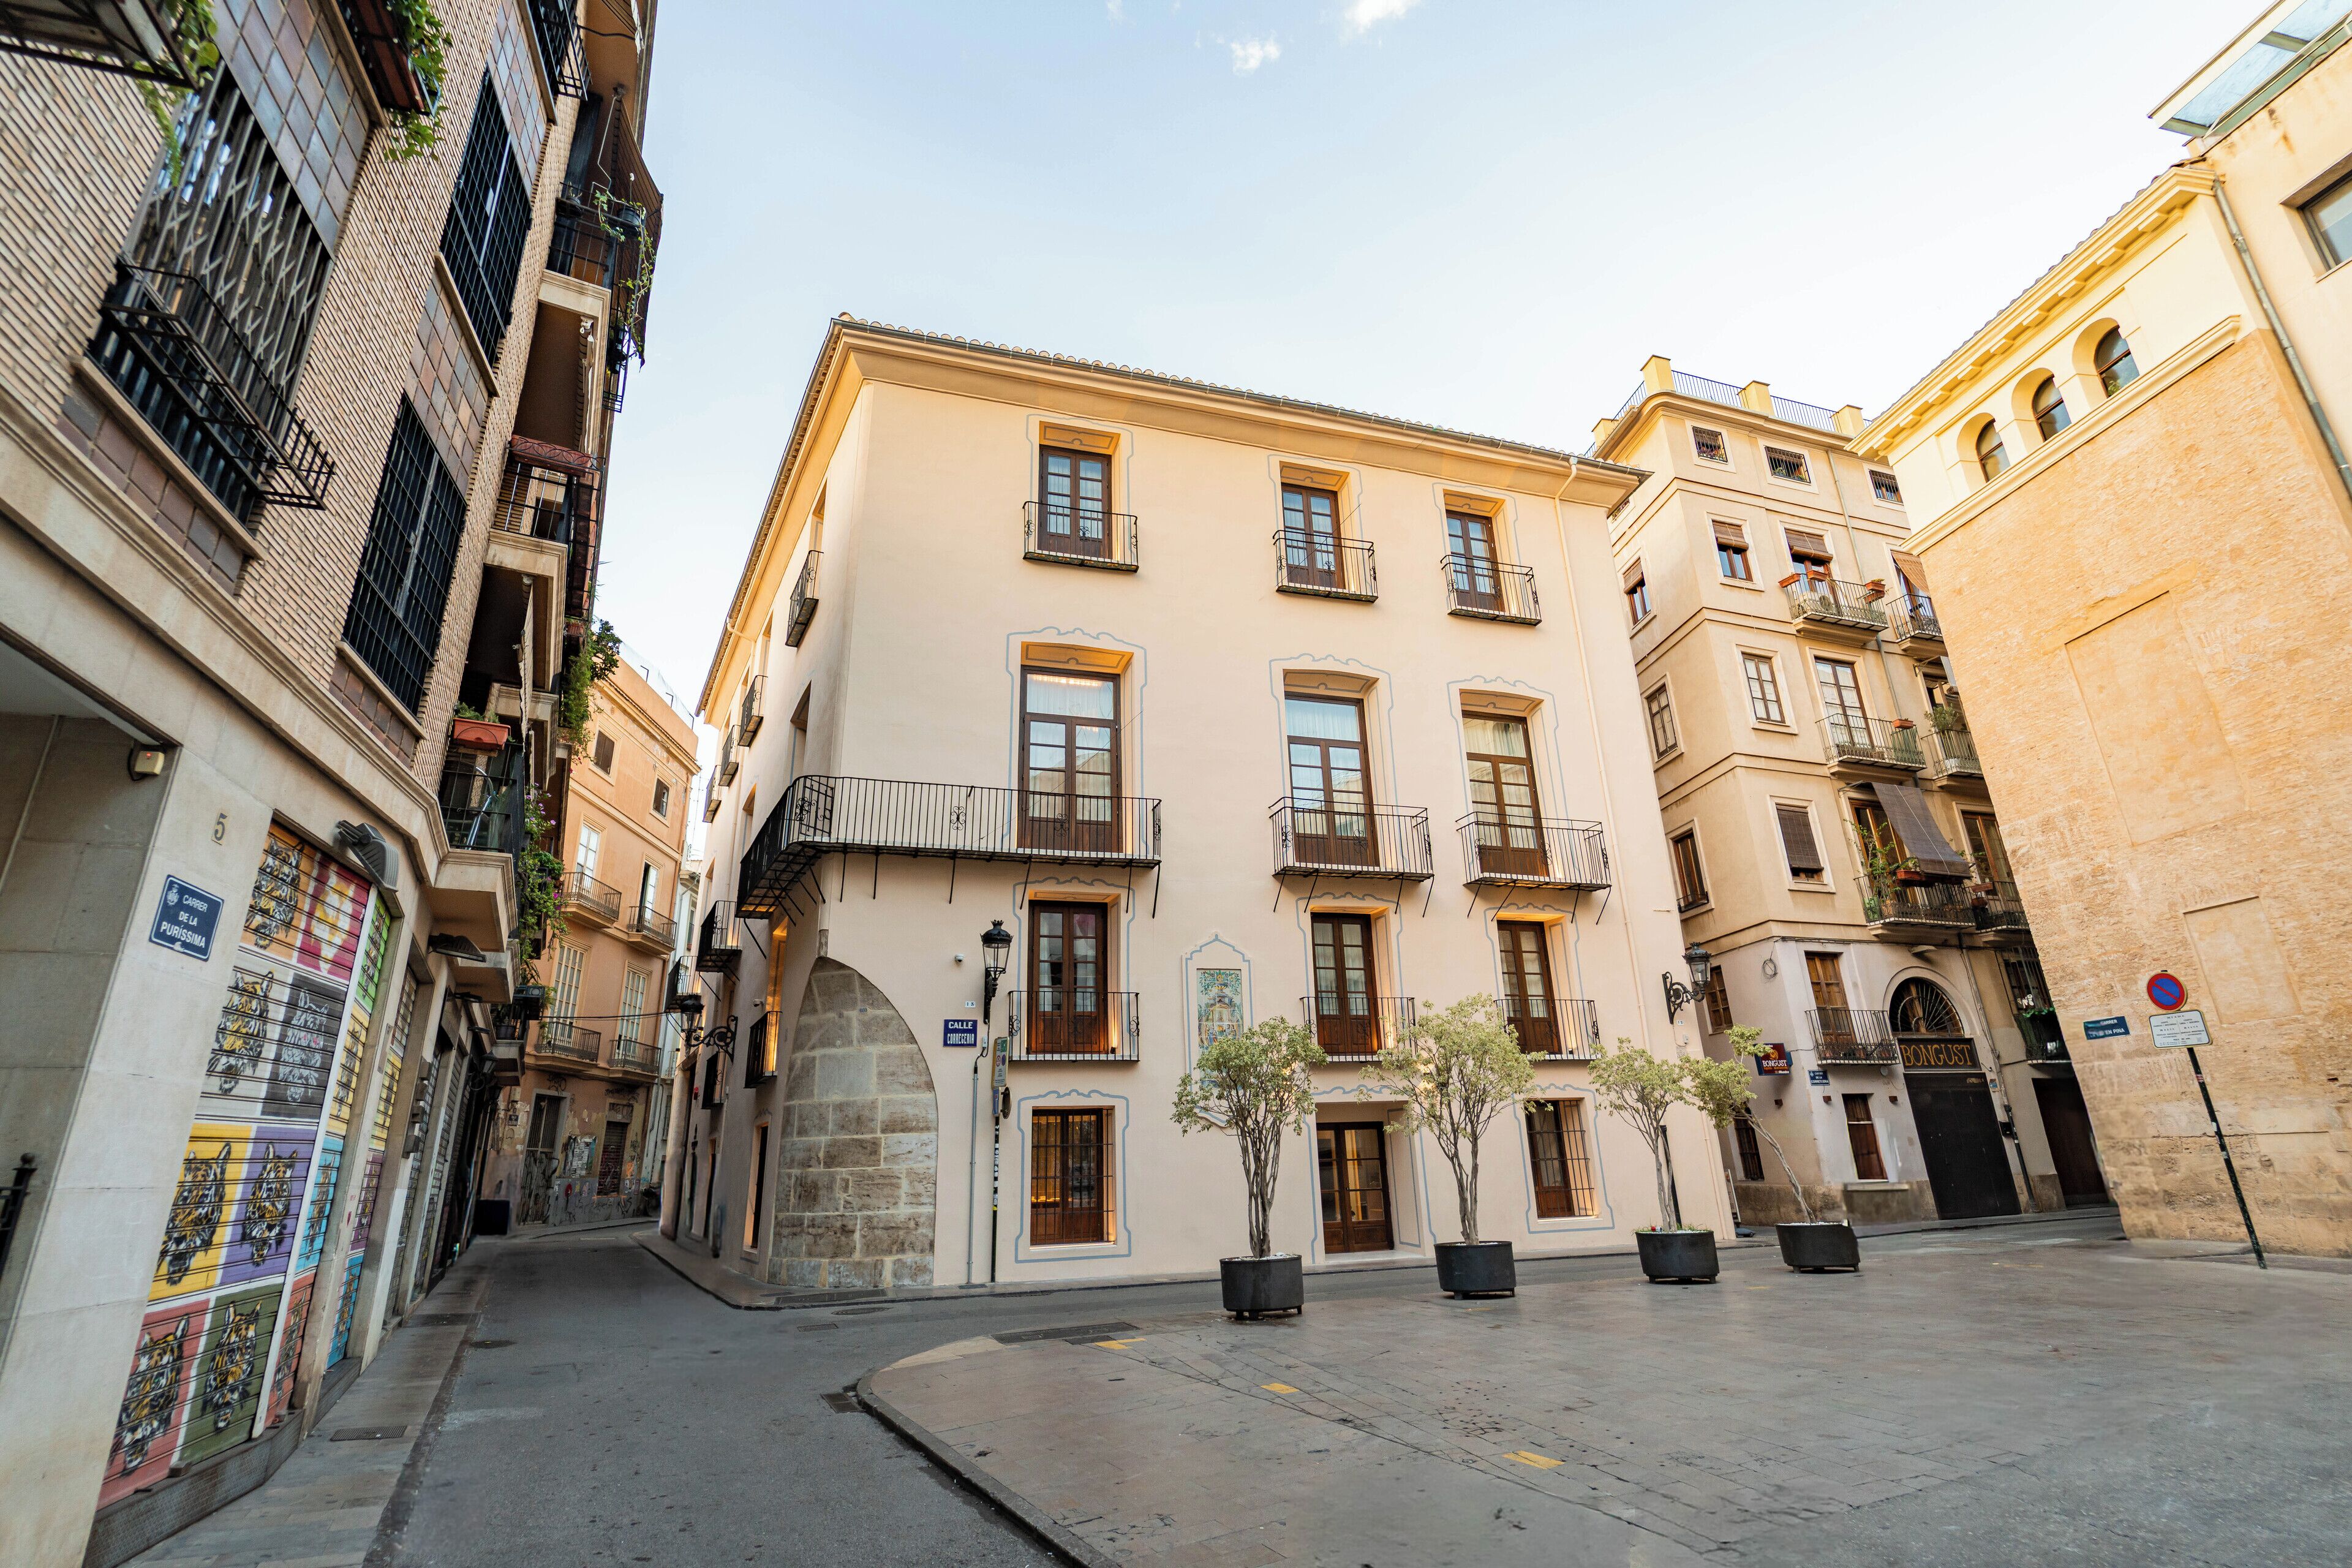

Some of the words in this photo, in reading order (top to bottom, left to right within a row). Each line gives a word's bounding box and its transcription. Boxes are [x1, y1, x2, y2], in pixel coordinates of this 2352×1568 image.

[214, 813, 227, 841] 5
[183, 895, 208, 912] CARRER
[179, 911, 189, 922] DE
[189, 916, 197, 926] LA
[160, 921, 206, 948] PURÍSSIMA
[1900, 1044, 1972, 1066] BONGUST
